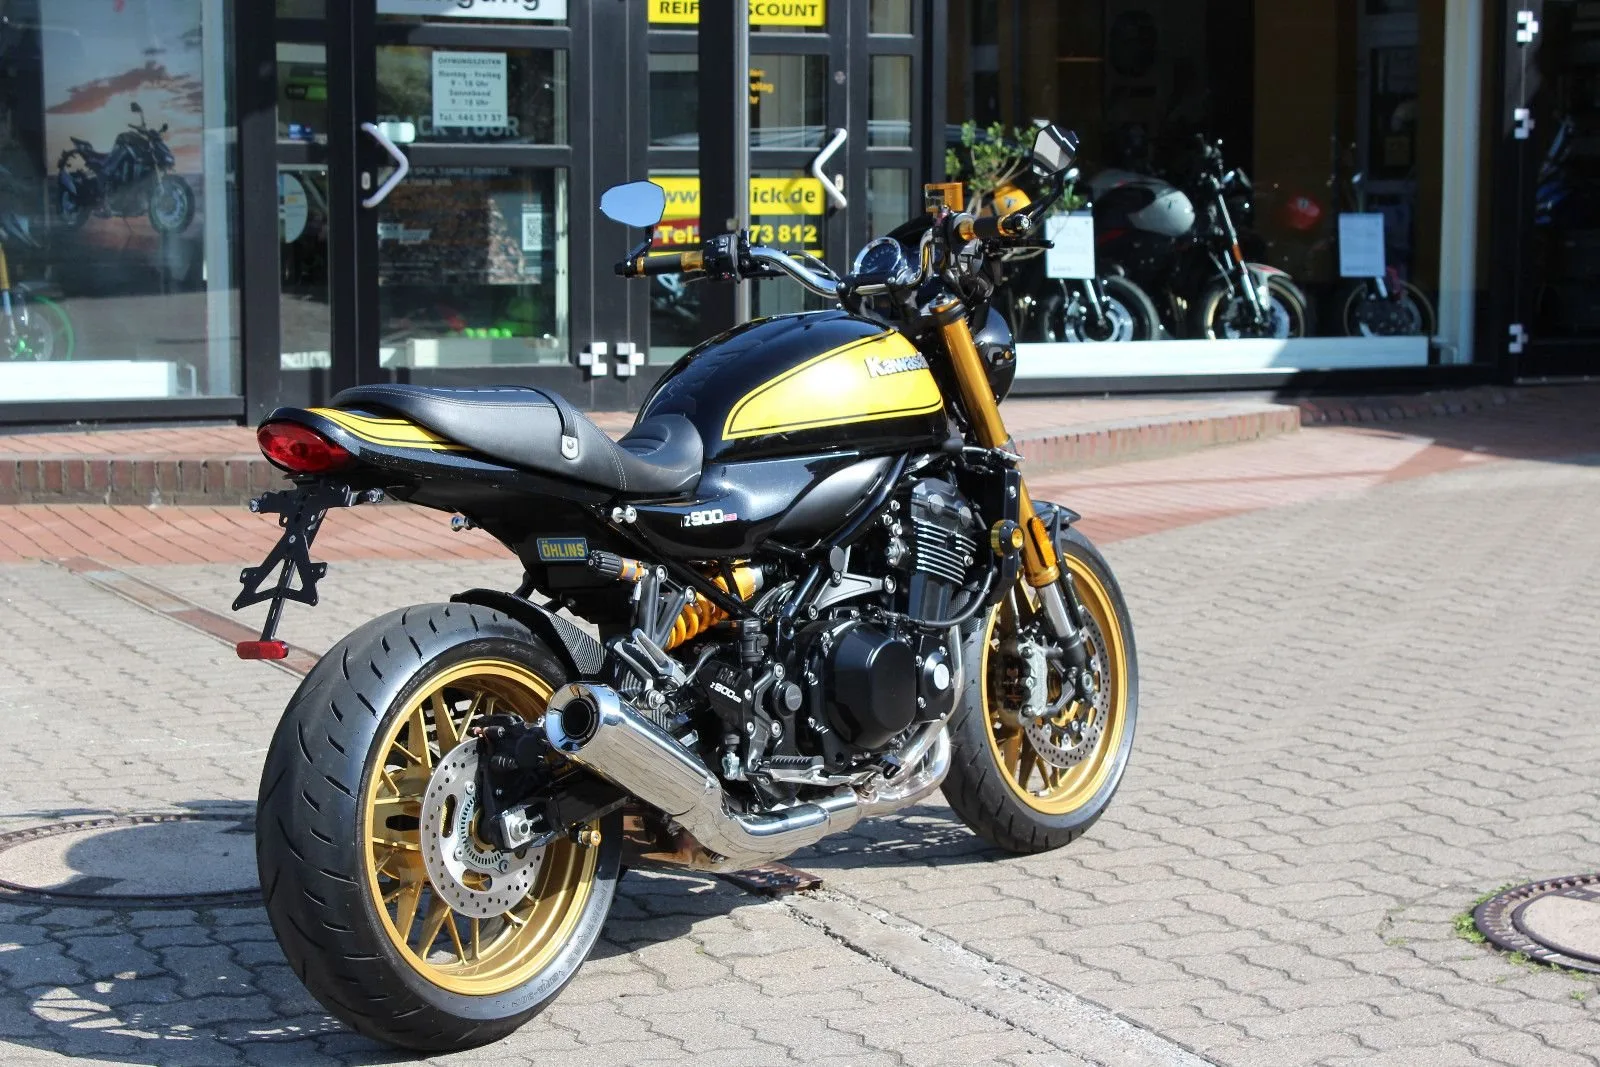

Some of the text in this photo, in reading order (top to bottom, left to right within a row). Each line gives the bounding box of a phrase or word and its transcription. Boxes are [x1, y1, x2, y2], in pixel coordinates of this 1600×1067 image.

[658, 225, 700, 244] Tel.
[778, 224, 817, 244] 812
[863, 352, 930, 378] Kawas
[541, 540, 585, 557] ÖHLINS
